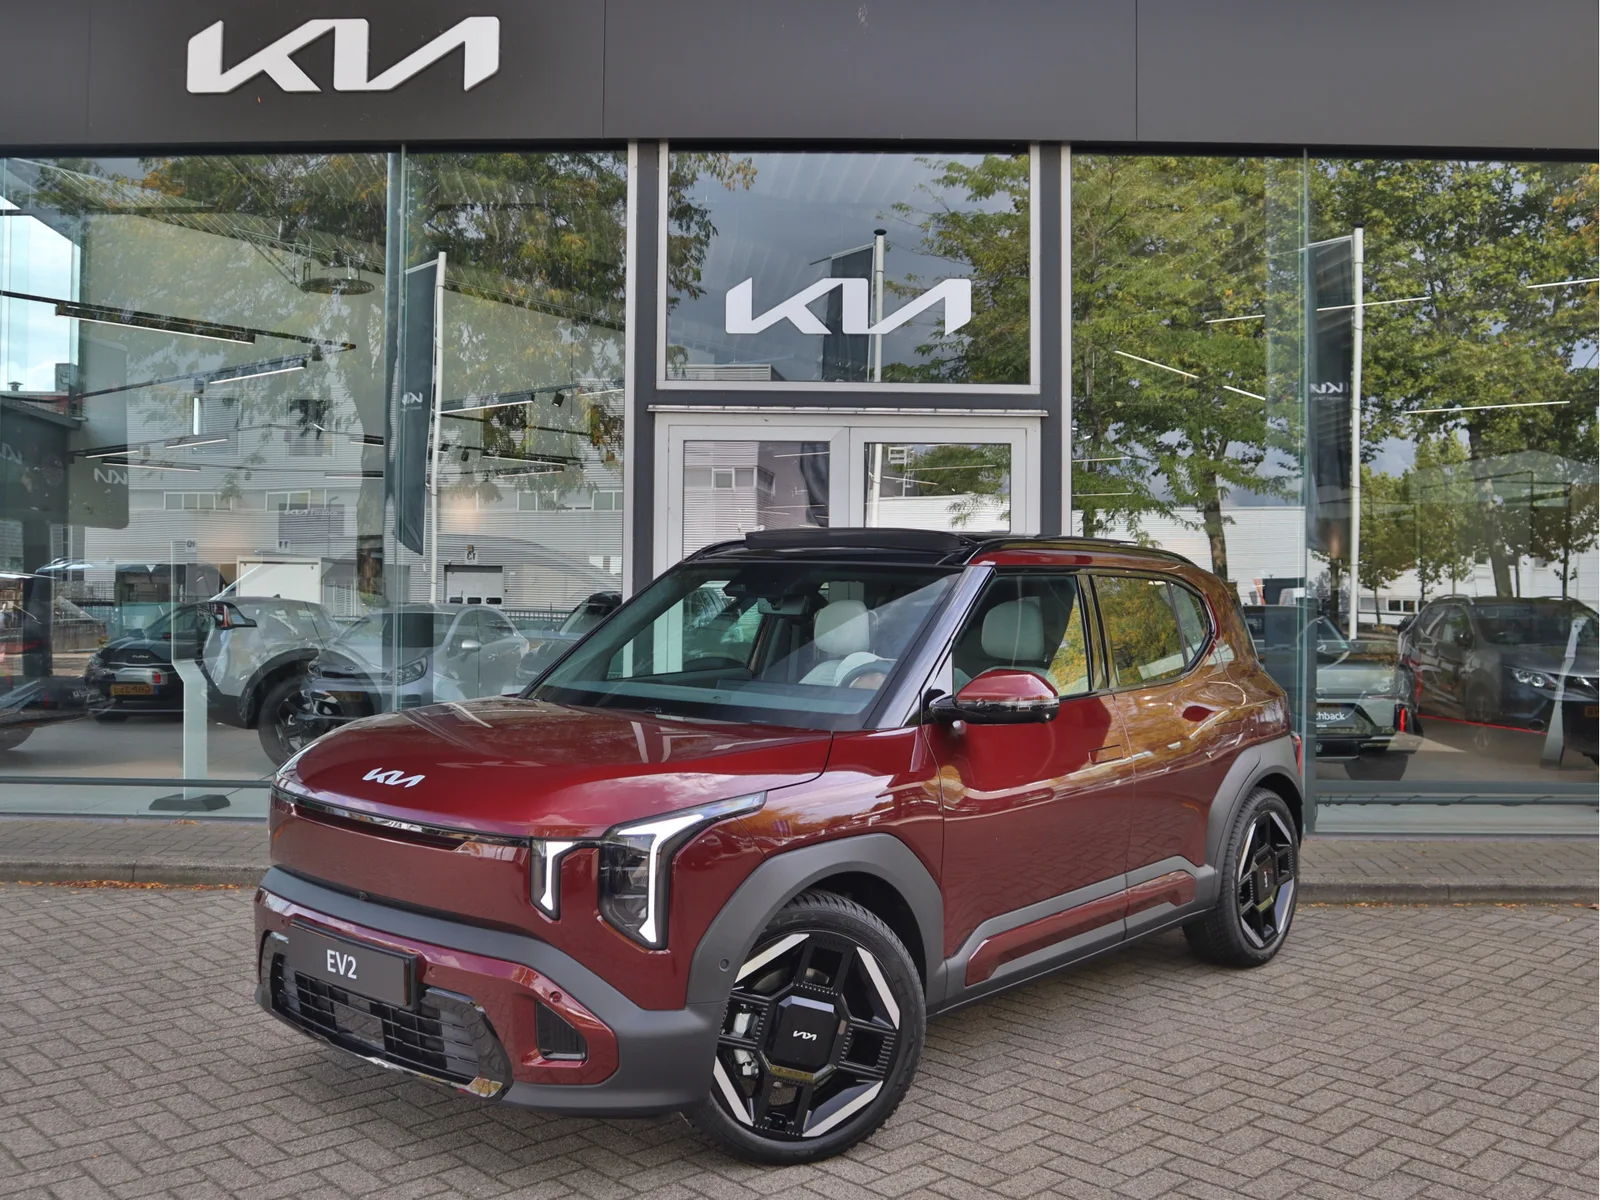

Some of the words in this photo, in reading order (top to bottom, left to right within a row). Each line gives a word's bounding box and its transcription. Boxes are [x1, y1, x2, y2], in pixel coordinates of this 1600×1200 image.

[187, 16, 500, 93] KIA
[725, 277, 972, 336] KIA
[362, 767, 426, 788] KIA
[327, 949, 357, 979] EV2
